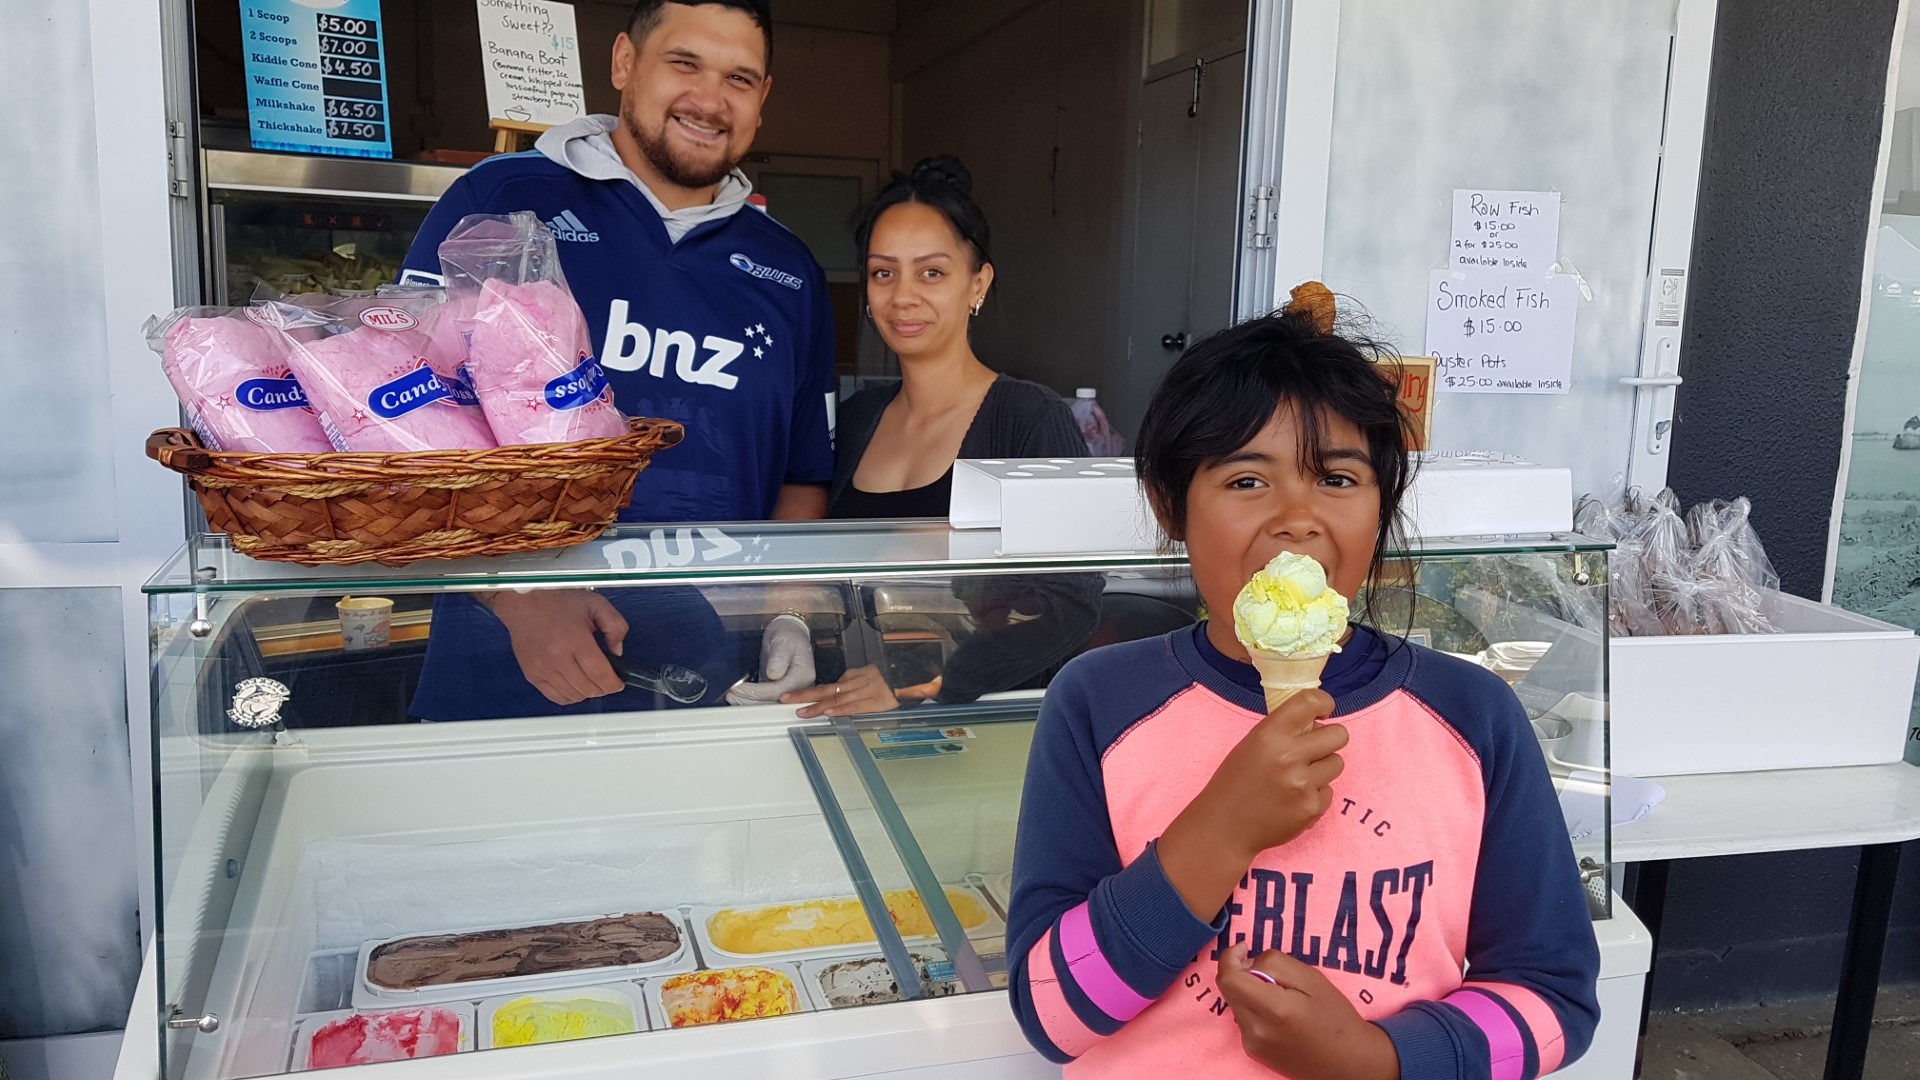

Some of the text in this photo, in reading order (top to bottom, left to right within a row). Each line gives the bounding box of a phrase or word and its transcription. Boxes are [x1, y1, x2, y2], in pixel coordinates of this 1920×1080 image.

[248, 8, 290, 24] 1 Scoop
[318, 14, 367, 35] $5.00
[502, 15, 554, 37] Sweet??
[250, 31, 298, 46] 2 Scoops
[320, 36, 367, 55] $7.00
[252, 53, 318, 70] Kiddie Cone
[488, 41, 568, 67] Banana Boat
[321, 56, 373, 76] $4.50
[253, 75, 320, 91] Waffle Cone
[255, 98, 316, 113] Milkshake
[326, 99, 377, 118] $6.50
[257, 120, 323, 134] Thickshake
[327, 119, 375, 138] $7.50
[1471, 193, 1540, 216] Raw Fish
[552, 227, 600, 243] didas
[1473, 220, 1516, 232] $15.00
[1455, 240, 1462, 249] 2
[1464, 239, 1476, 249] for
[1459, 255, 1499, 266] available
[752, 265, 803, 289] BLUES
[1437, 281, 1550, 311] Smoked Fish
[367, 308, 408, 326] MIL'S
[1463, 317, 1522, 338] $15.00
[600, 299, 745, 390] bnz
[1481, 354, 1507, 369] Pots
[1402, 369, 1428, 413] ing
[1445, 376, 1493, 389] $25.00
[1497, 378, 1533, 389] available
[1341, 797, 1391, 837] TIC
